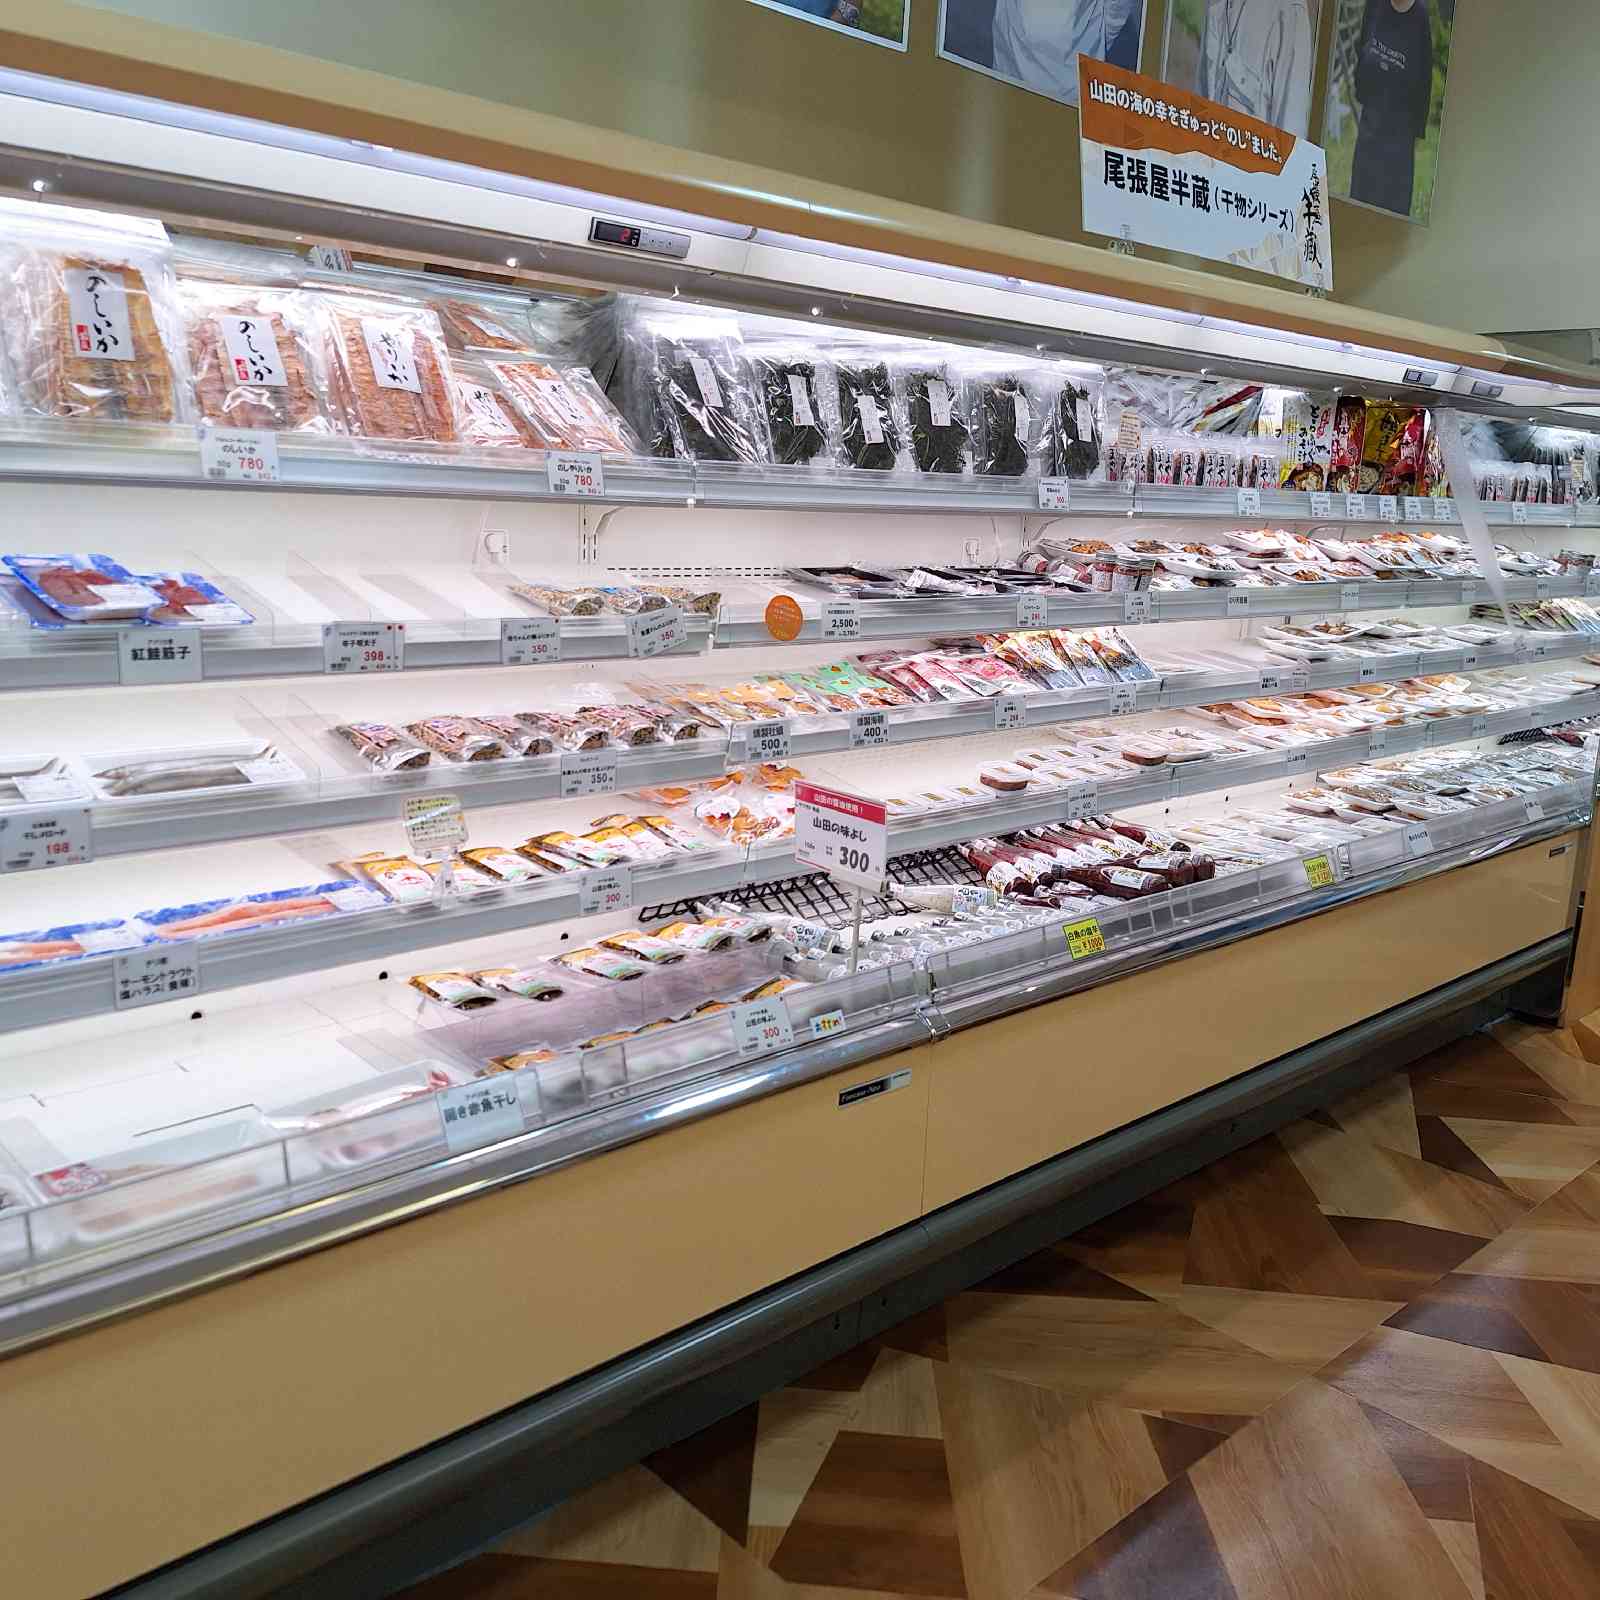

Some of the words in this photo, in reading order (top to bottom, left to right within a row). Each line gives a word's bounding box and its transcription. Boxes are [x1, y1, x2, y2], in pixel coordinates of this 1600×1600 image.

[86, 275, 119, 353] のしいか
[239, 320, 273, 382] のしいか
[238, 457, 264, 470] 780
[573, 474, 593, 486] 780
[831, 618, 854, 630] 2,500
[531, 644, 548, 655] 350
[362, 650, 385, 662] 398
[863, 726, 882, 738] 400
[761, 738, 781, 751] 500
[590, 773, 609, 785] 350
[812, 815, 868, 842] 山田の味よし
[839, 846, 870, 873] 300
[604, 892, 621, 904] 300
[762, 1026, 780, 1040] 300
